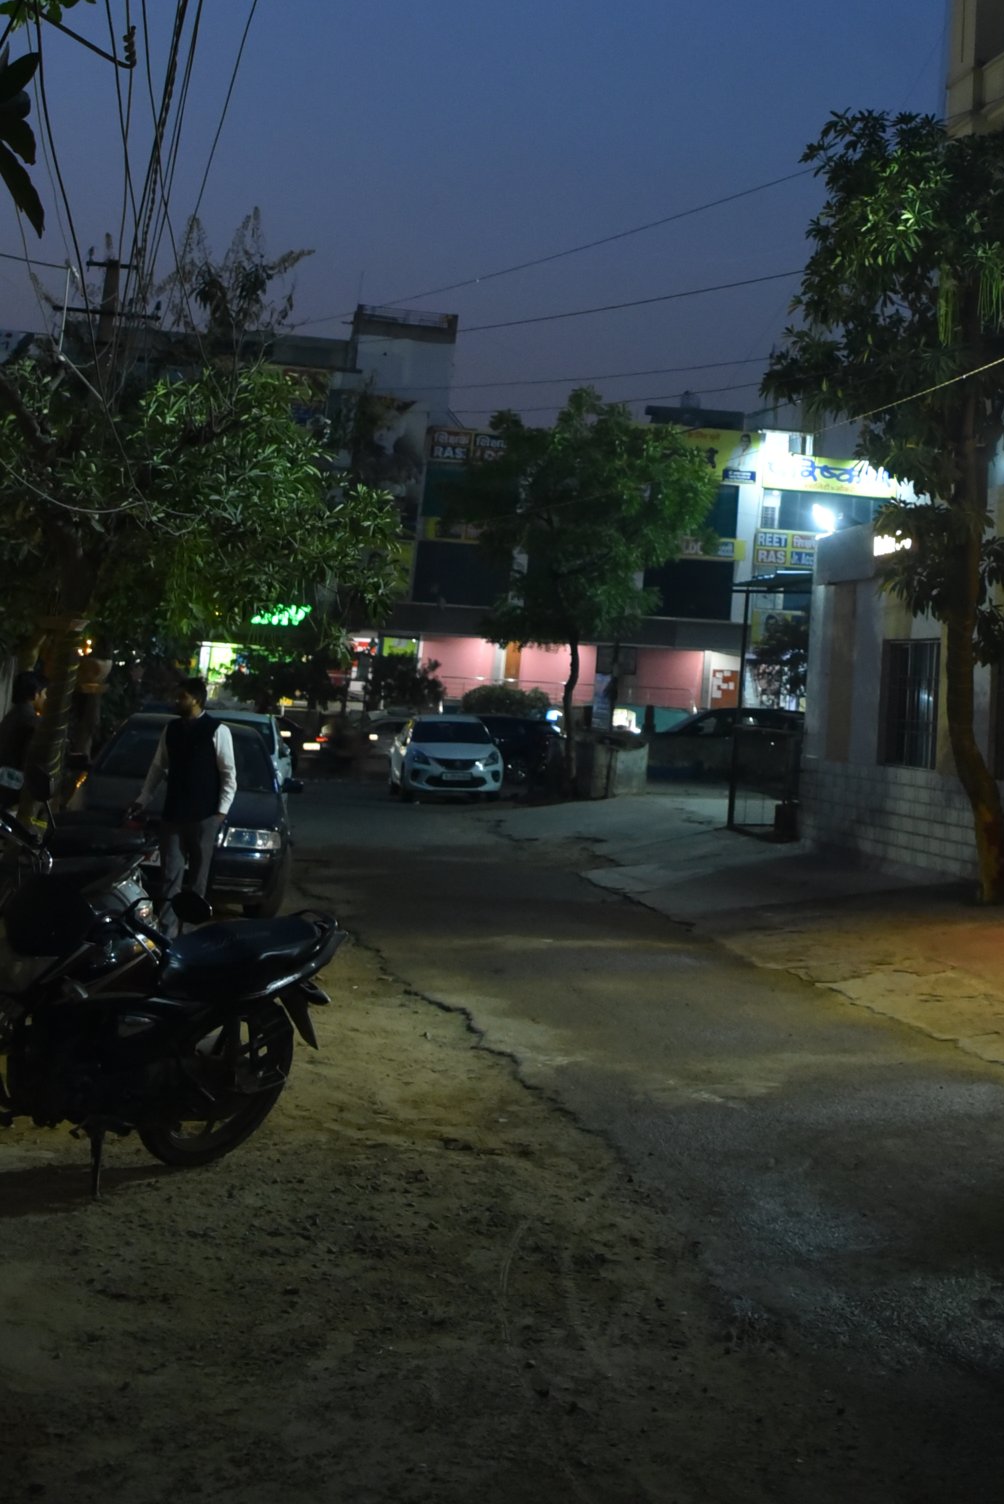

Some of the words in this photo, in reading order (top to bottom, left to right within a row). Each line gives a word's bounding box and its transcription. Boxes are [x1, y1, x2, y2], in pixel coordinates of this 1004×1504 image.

[433, 446, 467, 459] RAS
[758, 533, 787, 547] REET
[758, 550, 786, 563] RAS
